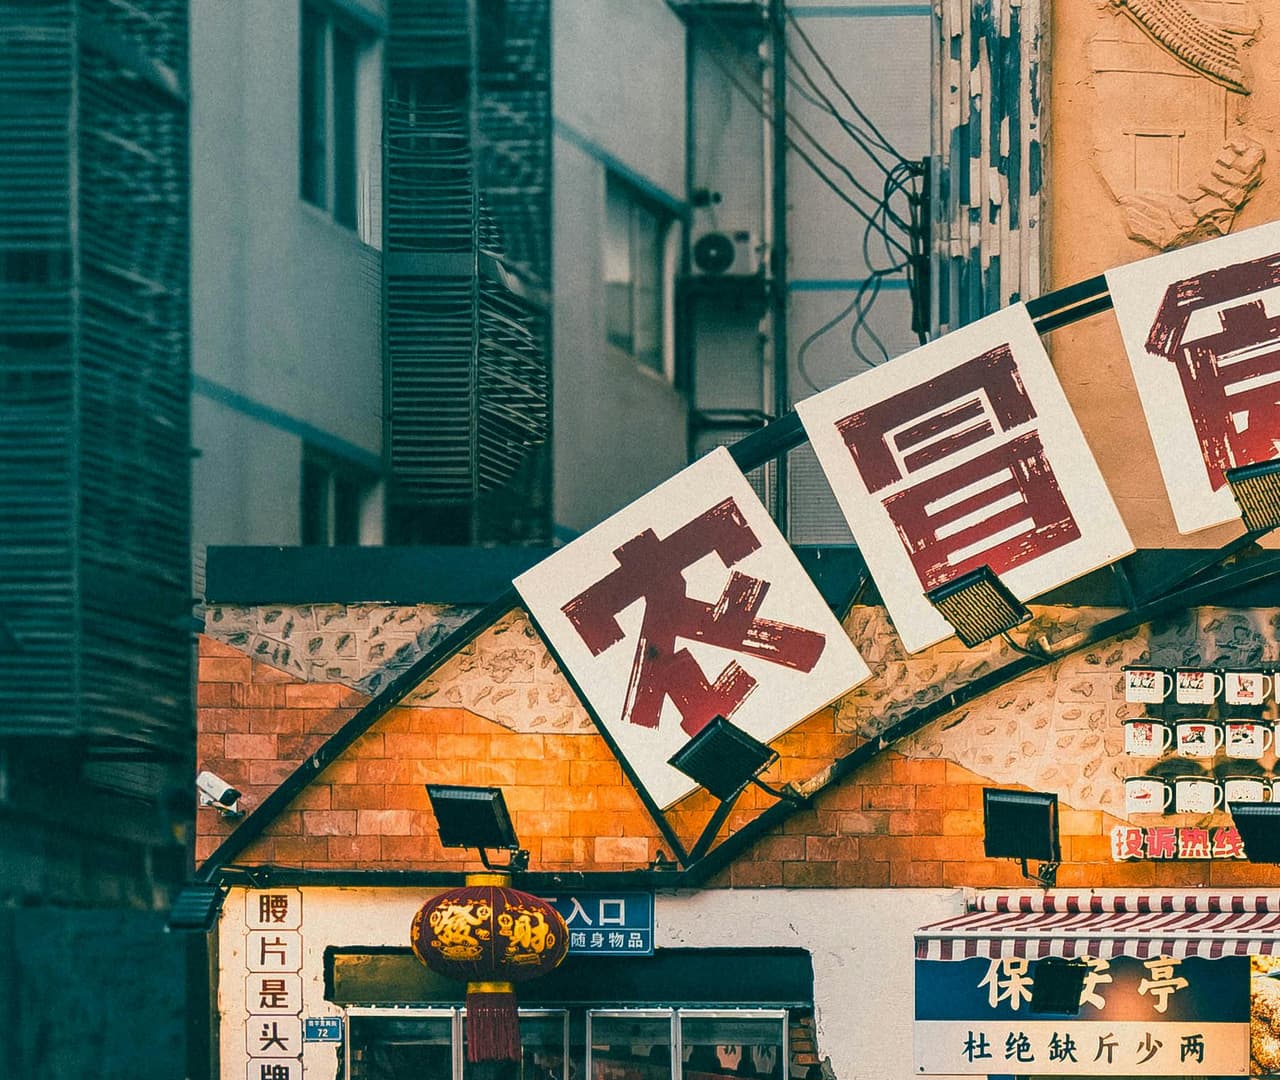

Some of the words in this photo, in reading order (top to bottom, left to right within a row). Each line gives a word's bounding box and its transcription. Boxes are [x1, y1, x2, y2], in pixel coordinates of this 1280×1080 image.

[1111, 826, 1247, 861] 投诉热线
[536, 896, 626, 927] 入口
[961, 1030, 1206, 1066] 杜绝缺斤少两
